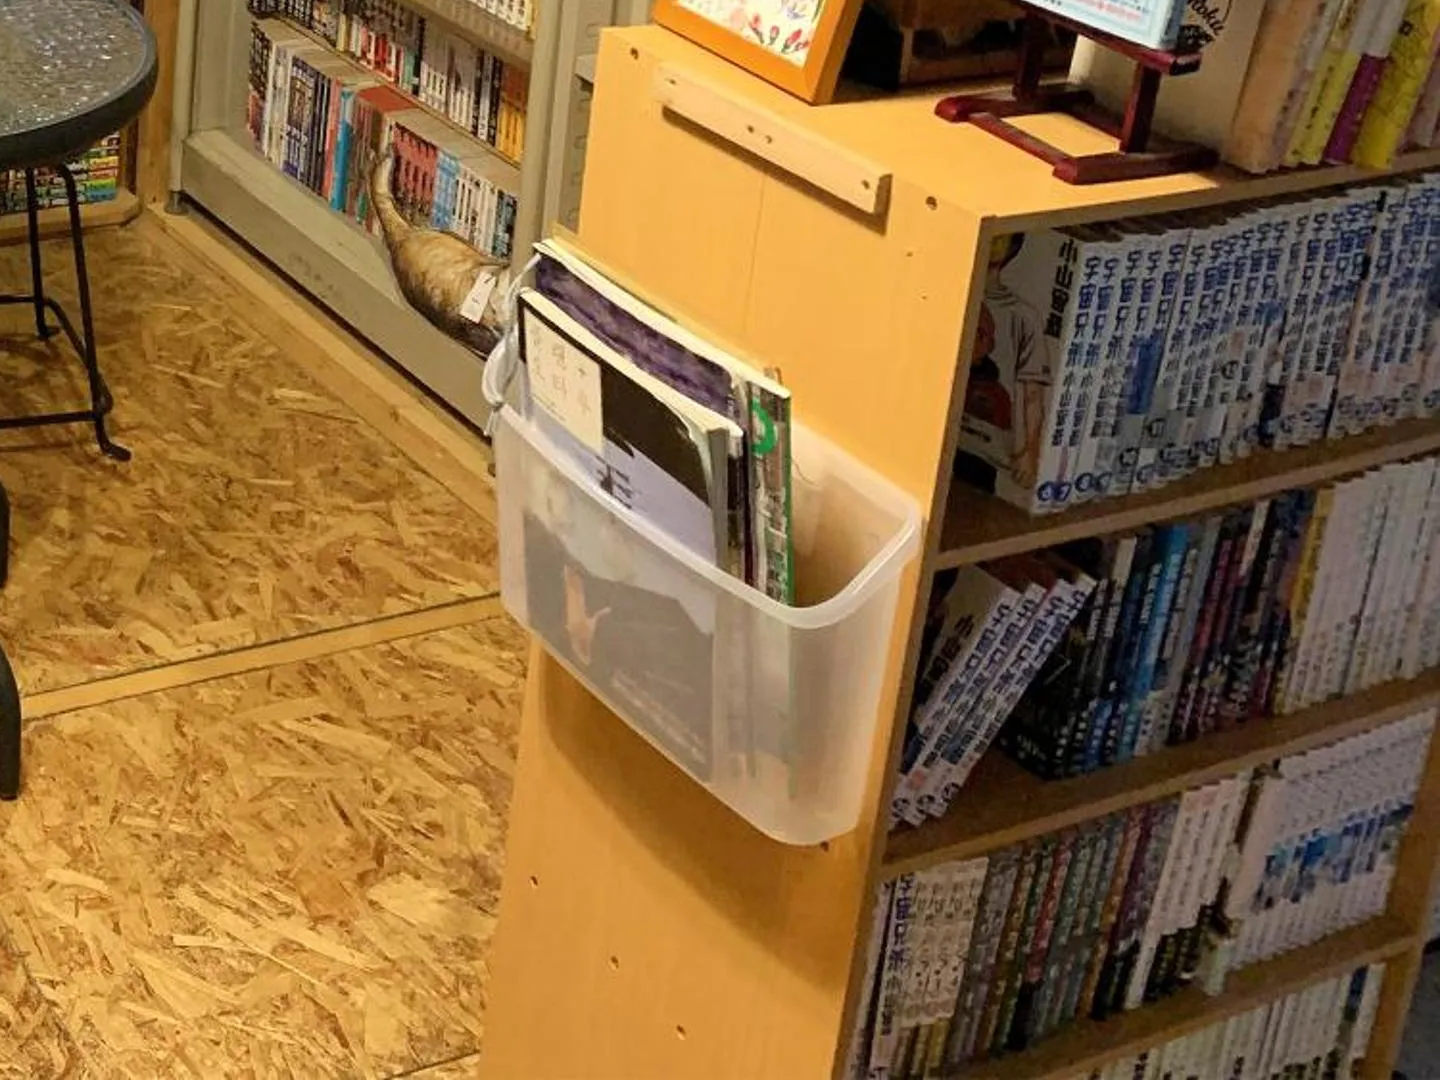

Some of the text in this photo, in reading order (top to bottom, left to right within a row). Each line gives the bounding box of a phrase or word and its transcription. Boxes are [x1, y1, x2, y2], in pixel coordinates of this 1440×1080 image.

[1066, 255, 1102, 368] 宇宙兄弟
[1084, 256, 1120, 368] 宇宙兄弟
[1107, 249, 1144, 360] 宇宙兄弟
